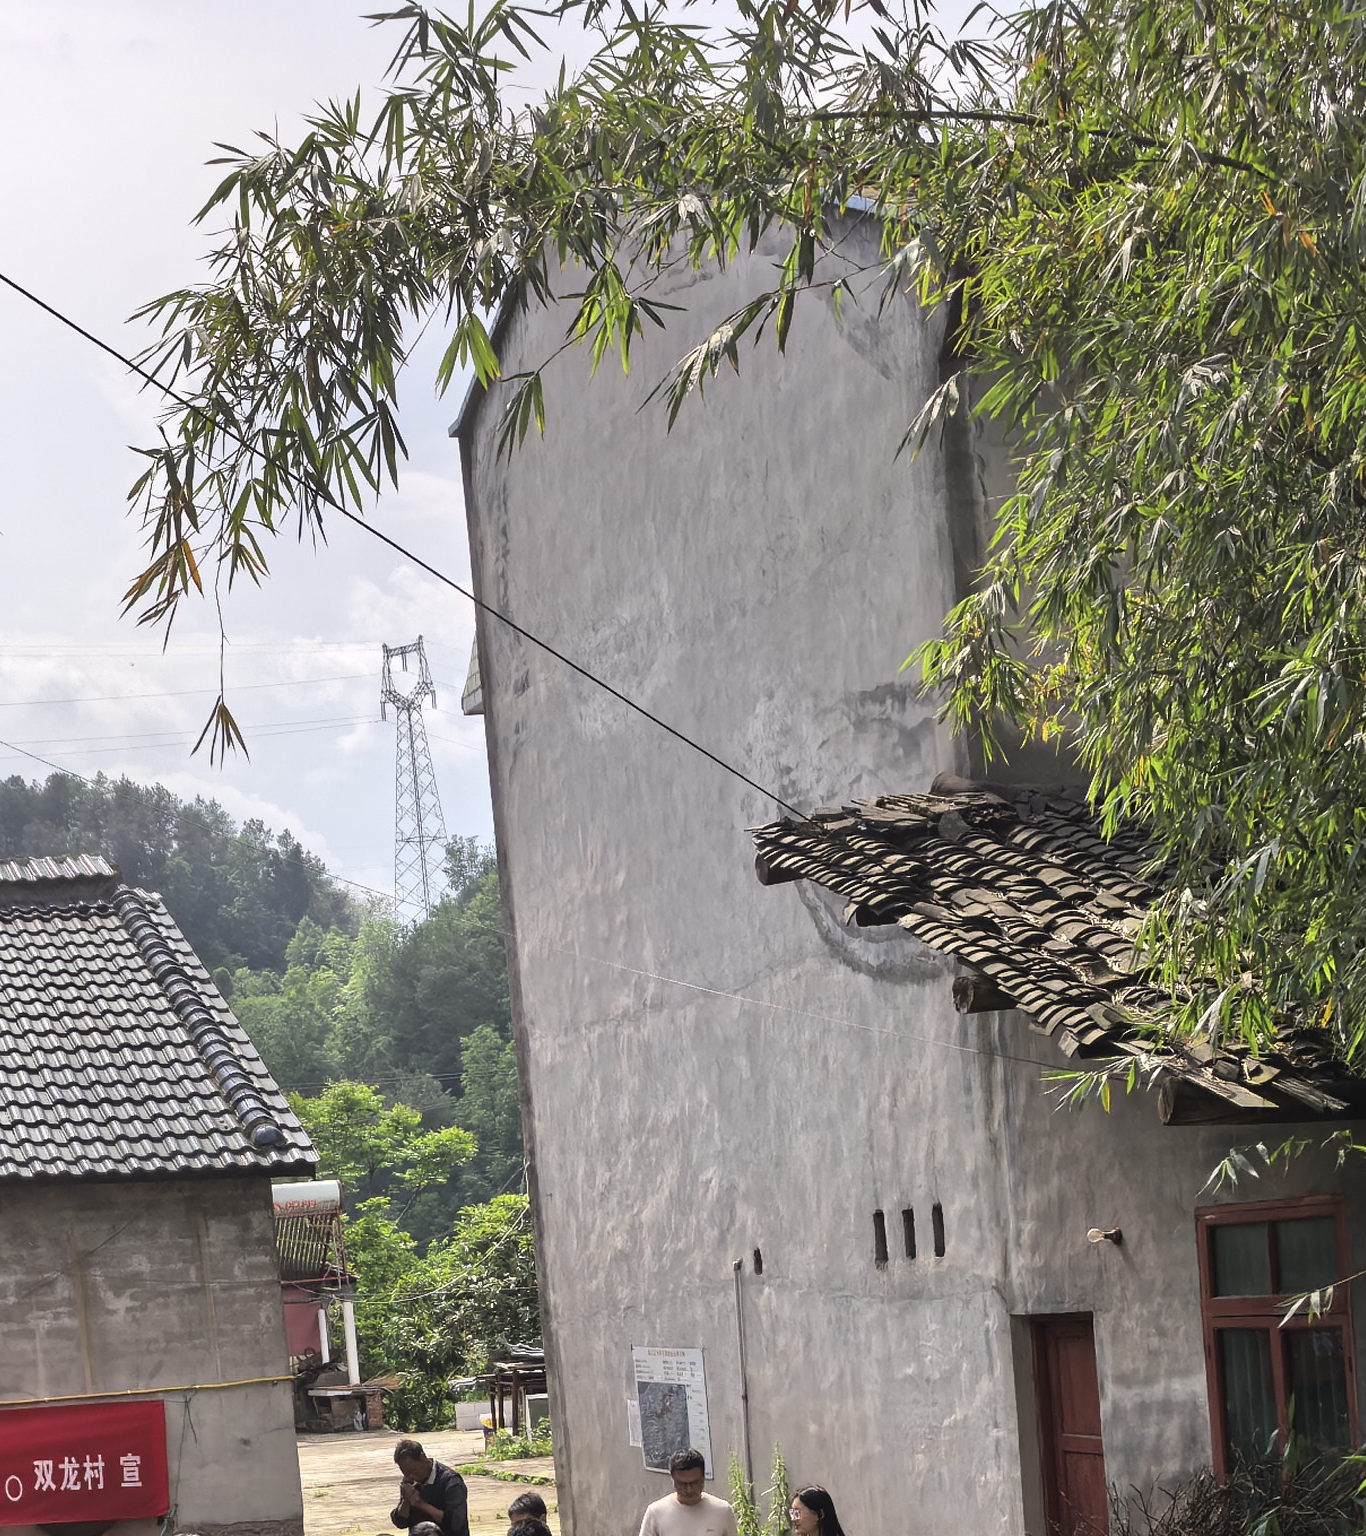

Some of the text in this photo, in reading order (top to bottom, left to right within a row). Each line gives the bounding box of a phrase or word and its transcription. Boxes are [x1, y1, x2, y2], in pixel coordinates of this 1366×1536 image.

[33, 1453, 143, 1491] 双龙村 宣
